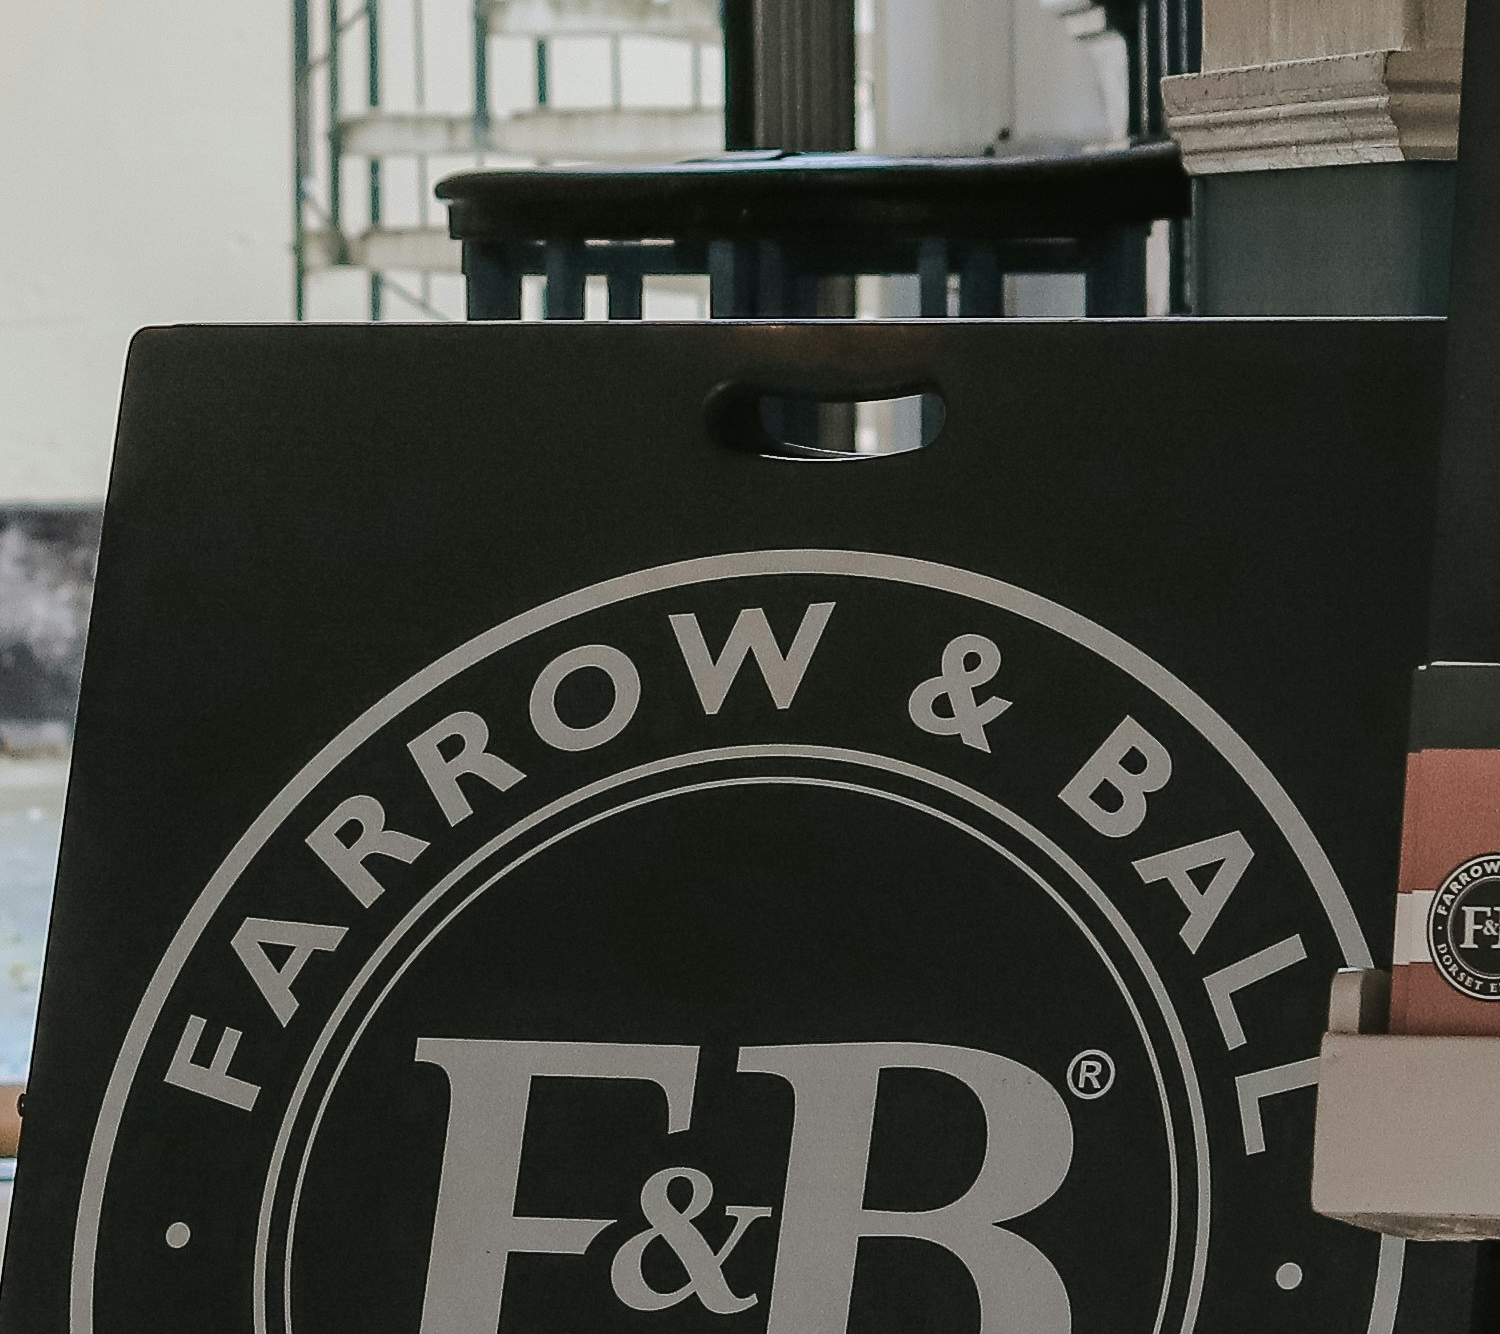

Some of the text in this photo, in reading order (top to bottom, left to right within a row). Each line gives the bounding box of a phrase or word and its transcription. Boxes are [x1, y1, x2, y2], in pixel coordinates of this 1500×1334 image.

[165, 601, 1322, 1157] FARROW & BALL
[1437, 942, 1484, 991] DORSET
